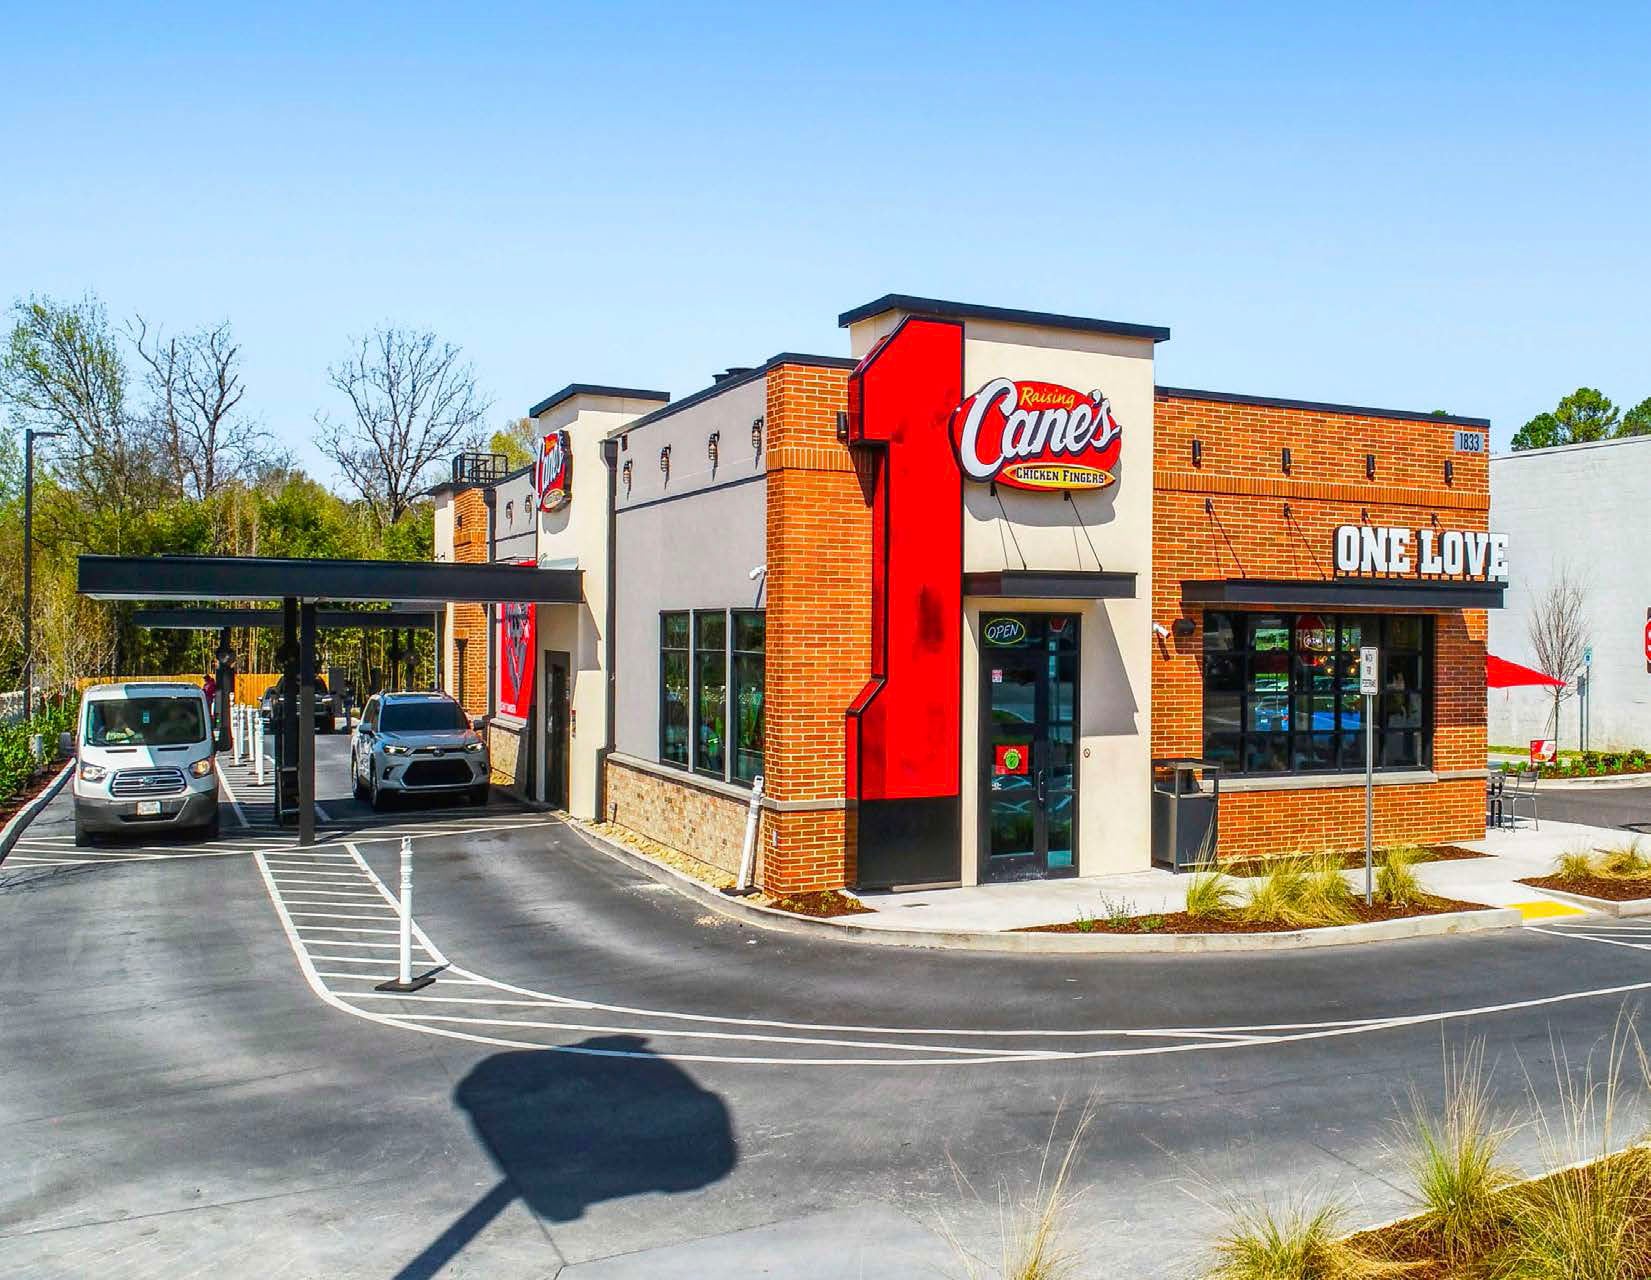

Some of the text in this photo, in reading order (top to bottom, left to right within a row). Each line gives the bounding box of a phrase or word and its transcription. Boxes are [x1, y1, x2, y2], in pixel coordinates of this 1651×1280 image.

[1020, 387, 1076, 410] Raising
[961, 377, 1122, 482] Cane's
[1459, 433, 1480, 451] 1833
[1016, 467, 1104, 484] CHICKEN FINGERS
[1336, 525, 1509, 576] ONE LOVE
[988, 623, 1019, 639] OPEN
